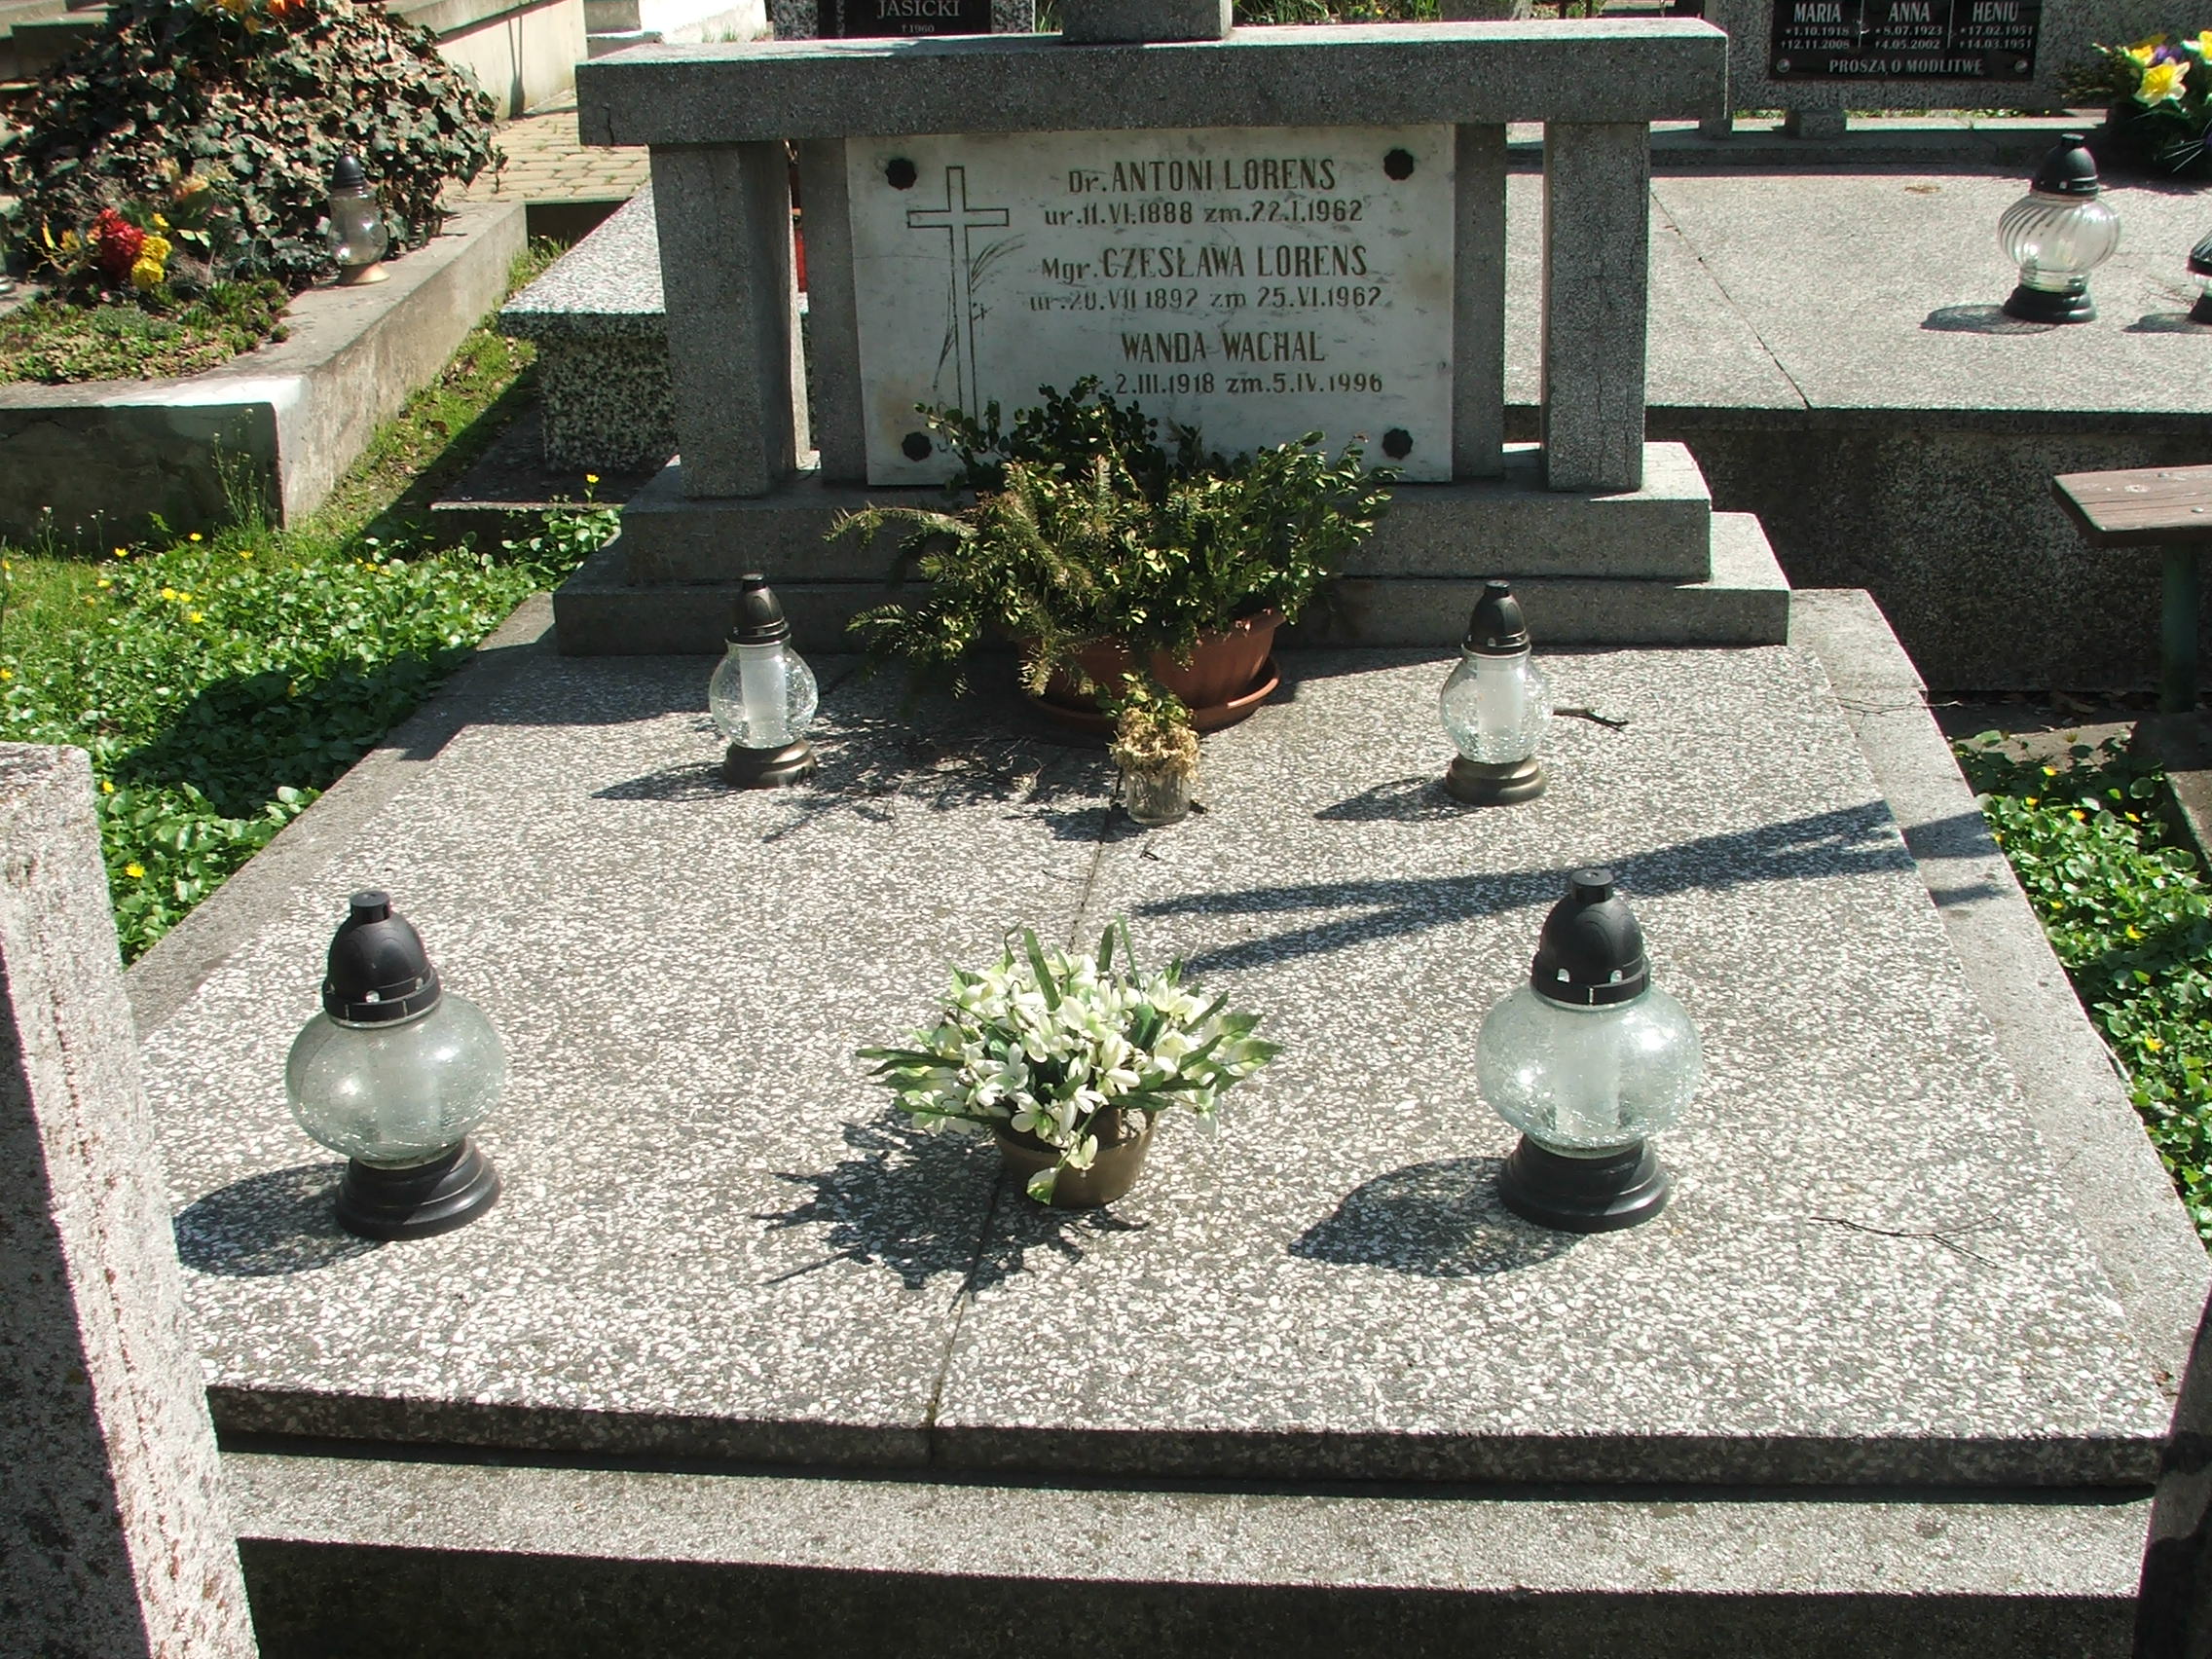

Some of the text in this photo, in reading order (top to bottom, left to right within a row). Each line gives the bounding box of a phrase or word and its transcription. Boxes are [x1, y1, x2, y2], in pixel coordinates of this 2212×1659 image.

[877, 0, 960, 18] JASICKI
[1793, 3, 1841, 22] MARIA
[1889, 2, 1930, 21] ANNA
[1972, 1, 2019, 21] HENIU
[1891, 59, 1901, 73] O
[1069, 158, 1336, 193] Dr. ANTONI LORENS
[1042, 244, 1367, 285] Mgr. CZESŁAWA LORENS
[1121, 331, 1325, 363] WANDA WACHAL
